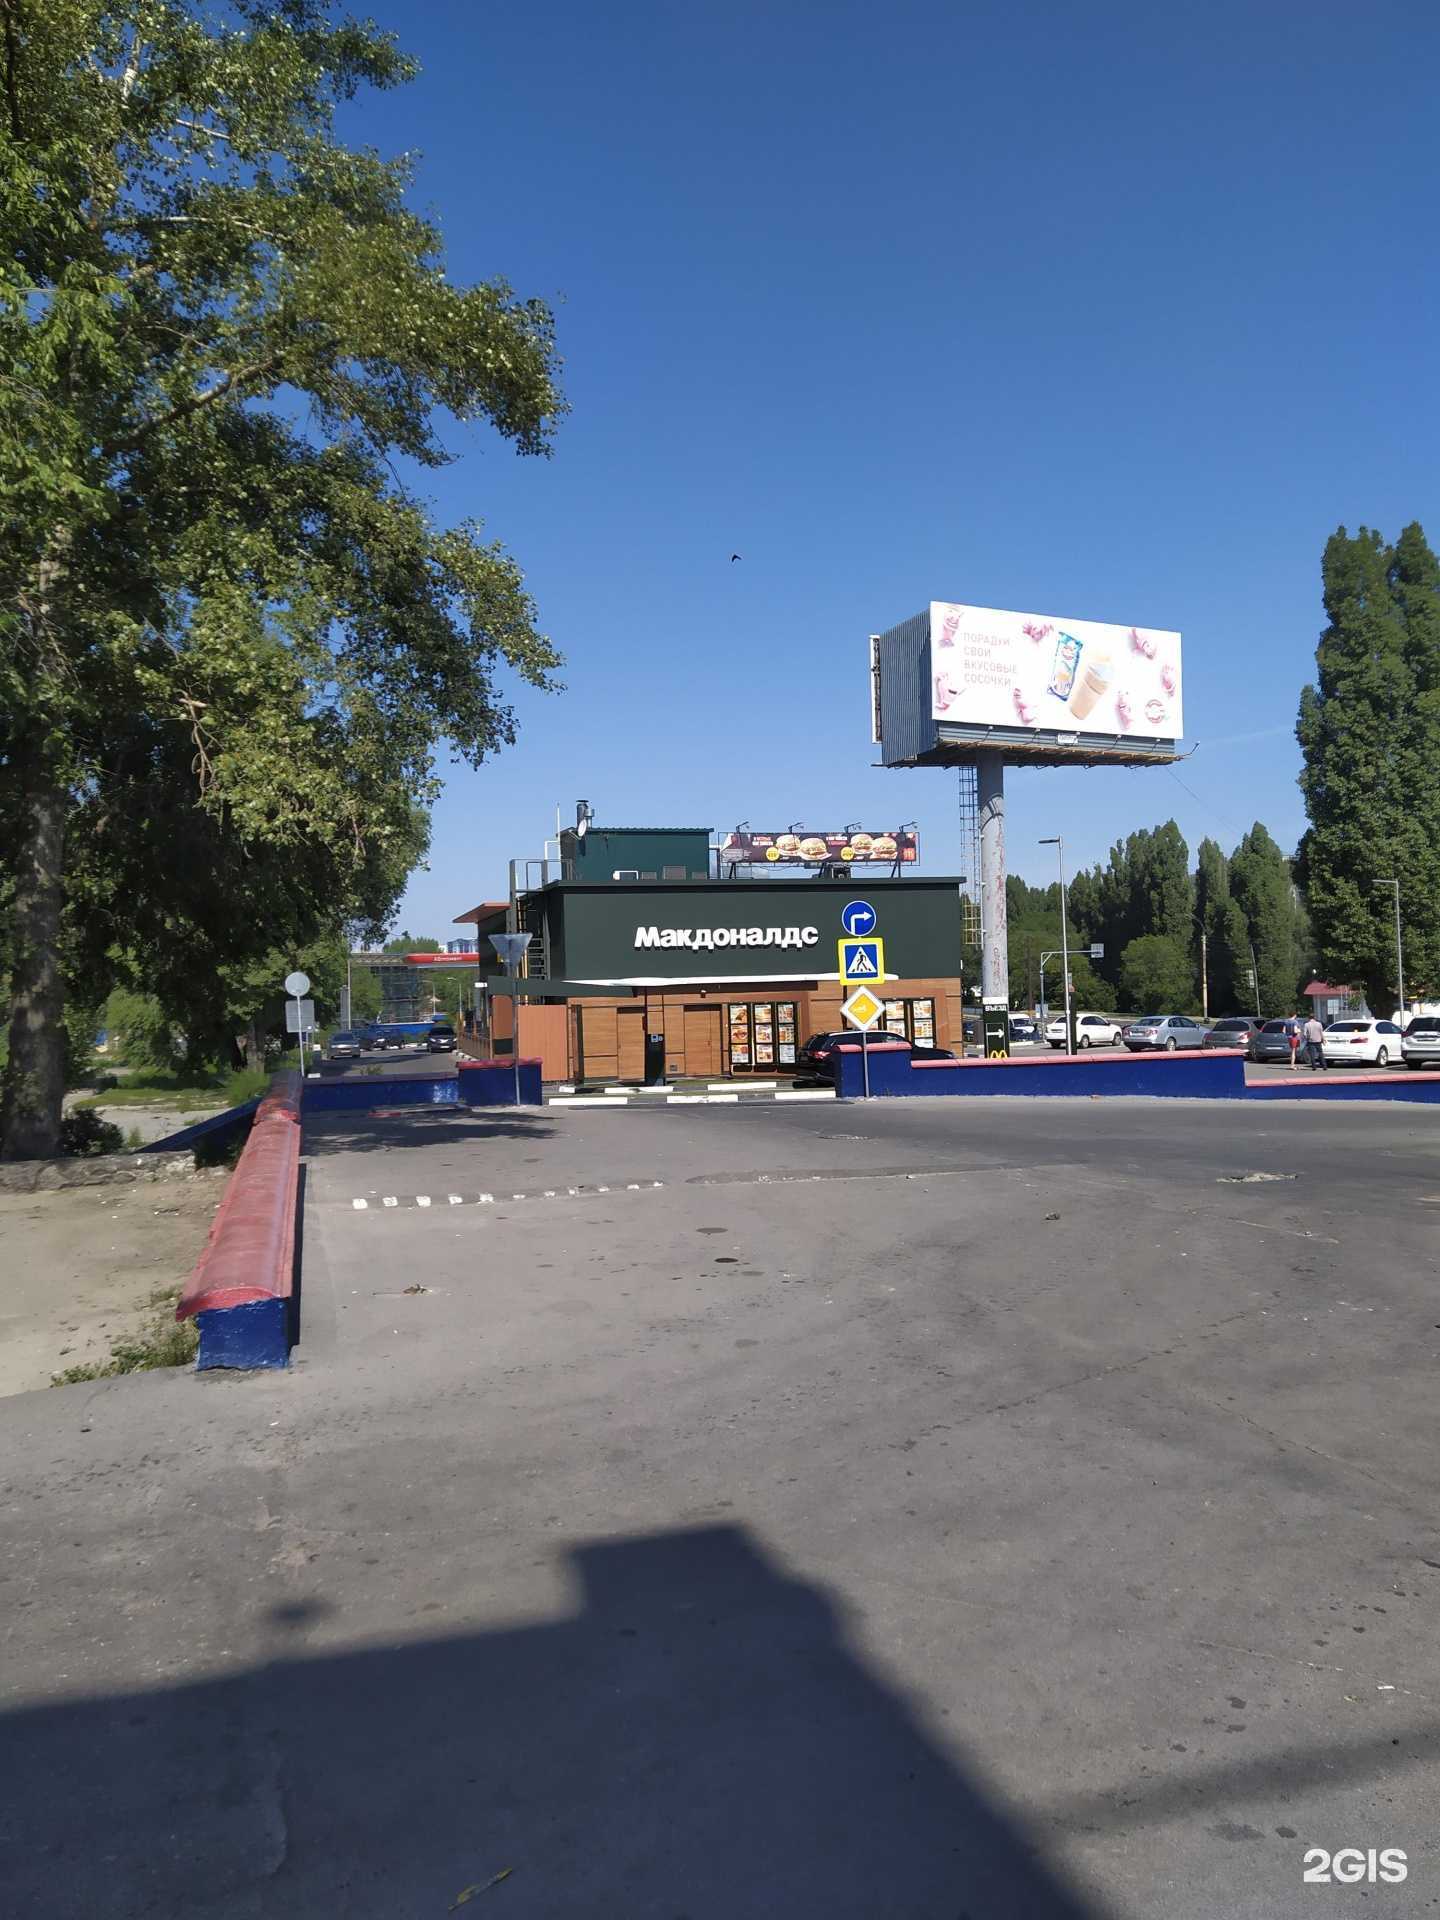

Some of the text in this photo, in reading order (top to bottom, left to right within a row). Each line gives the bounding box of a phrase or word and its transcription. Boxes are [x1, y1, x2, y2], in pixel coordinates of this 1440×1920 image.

[963, 659, 1017, 674] ВКУСОВЫЕ
[963, 673, 1012, 687] СОСОЧКИ
[634, 926, 819, 951] Макдоналдс
